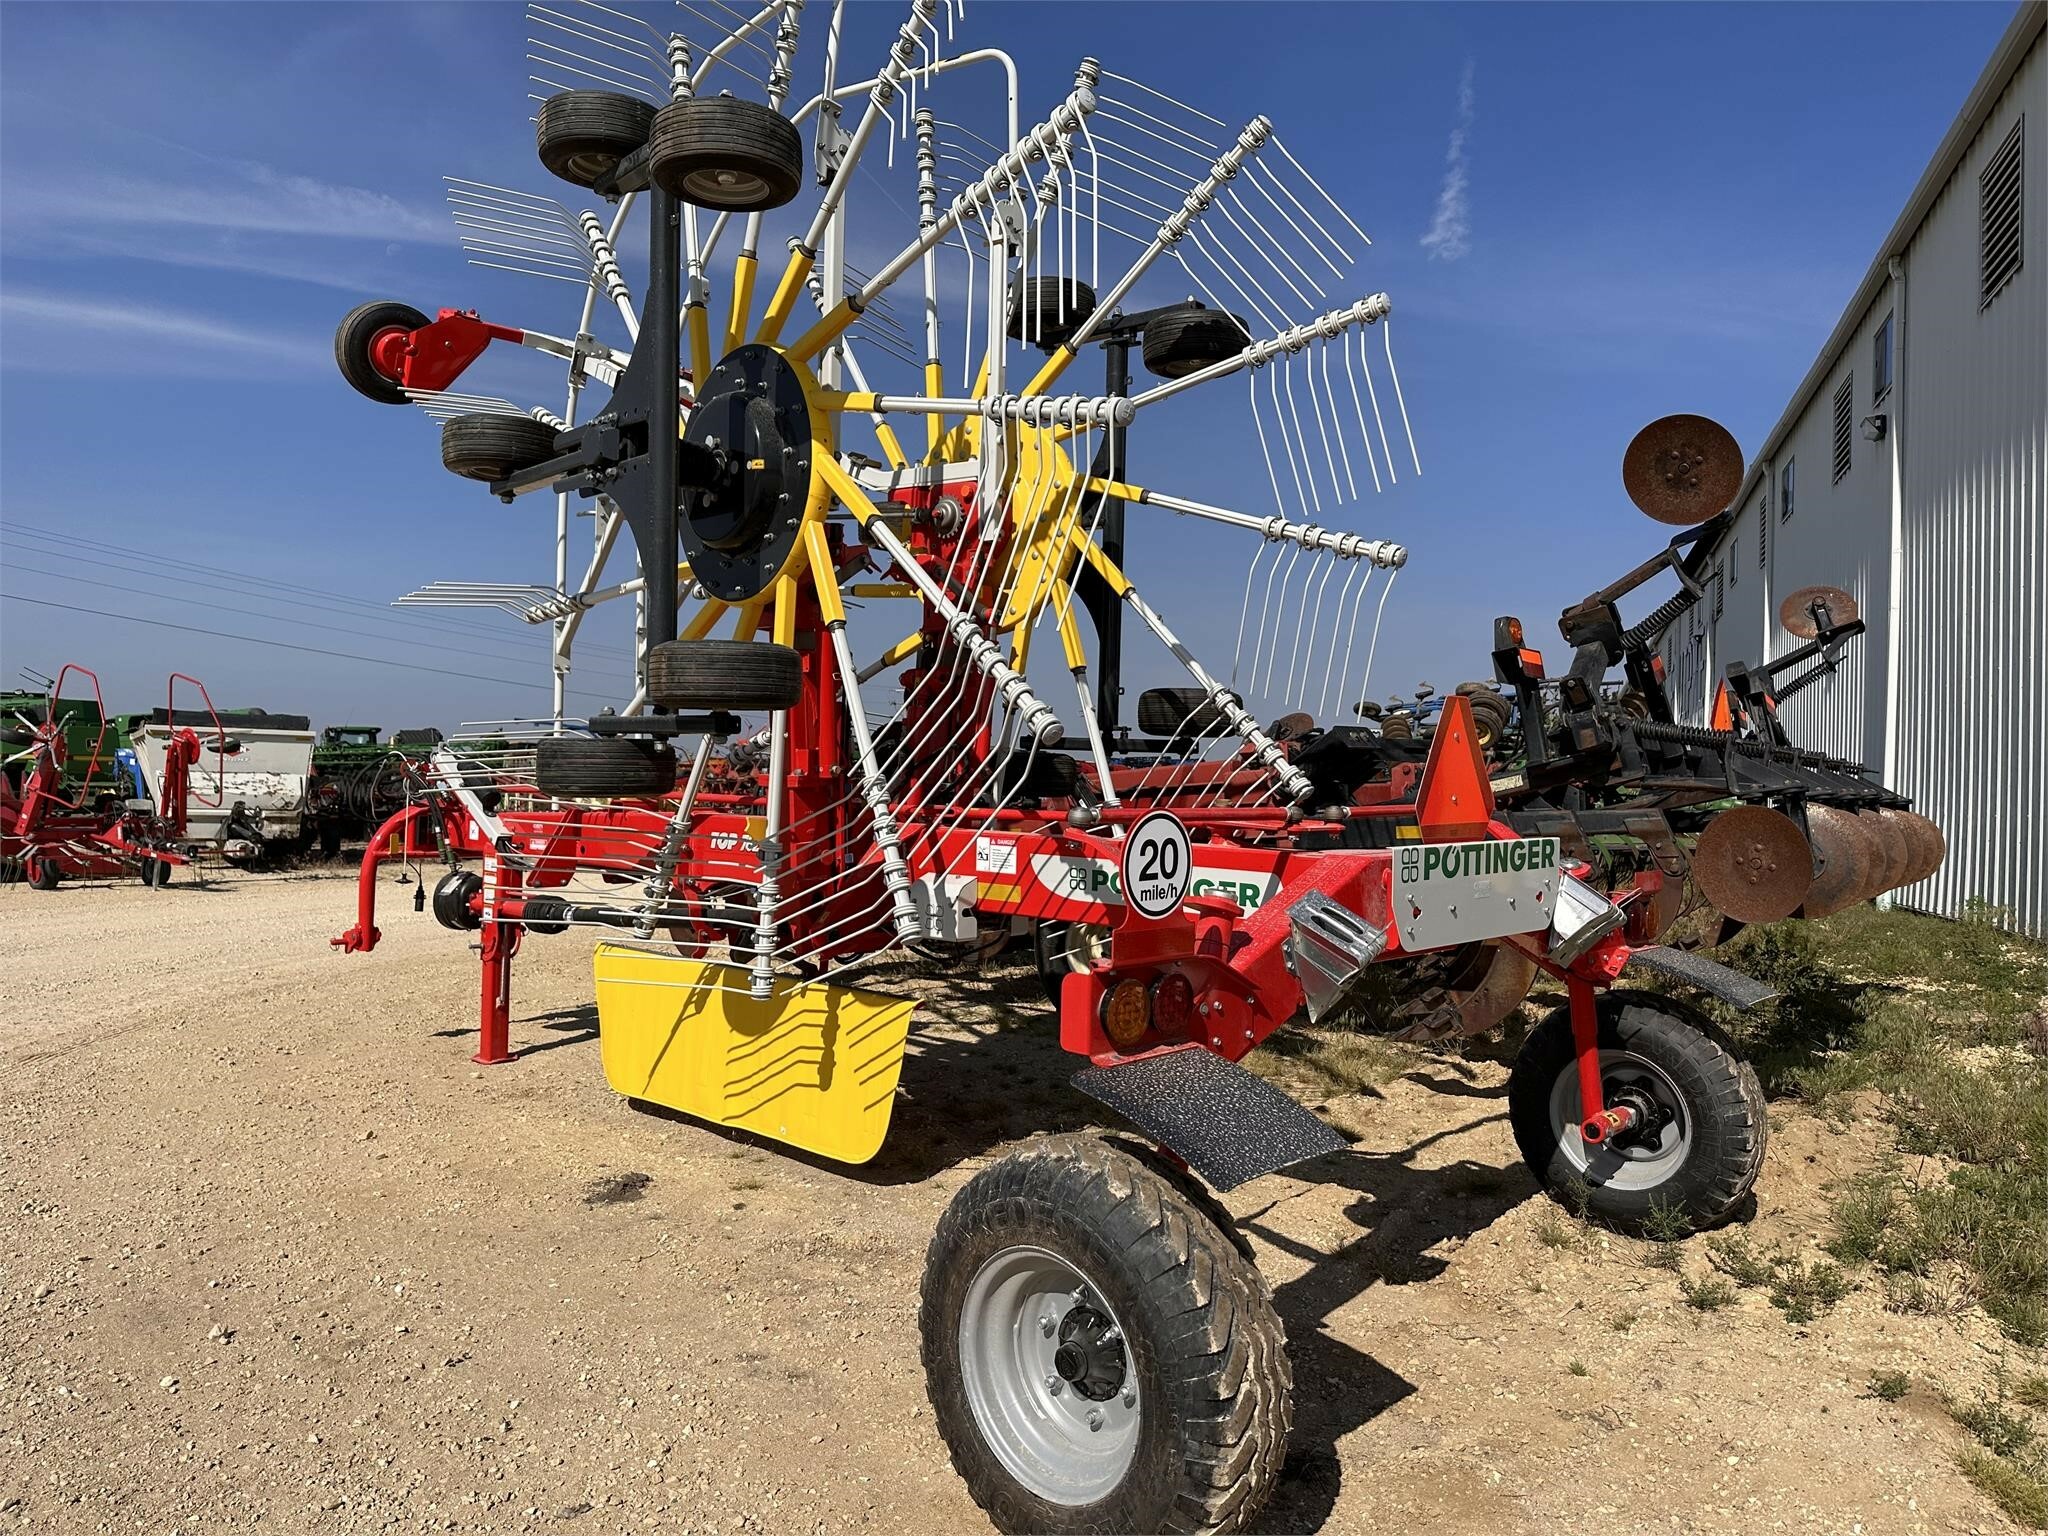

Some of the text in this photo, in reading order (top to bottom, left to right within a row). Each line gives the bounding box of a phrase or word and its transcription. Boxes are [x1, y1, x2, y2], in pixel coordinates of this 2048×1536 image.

[710, 831, 738, 850] TOP
[1139, 837, 1179, 882] 20
[1424, 838, 1555, 881] PÖTTINGER
[1140, 883, 1178, 902] mile/h
